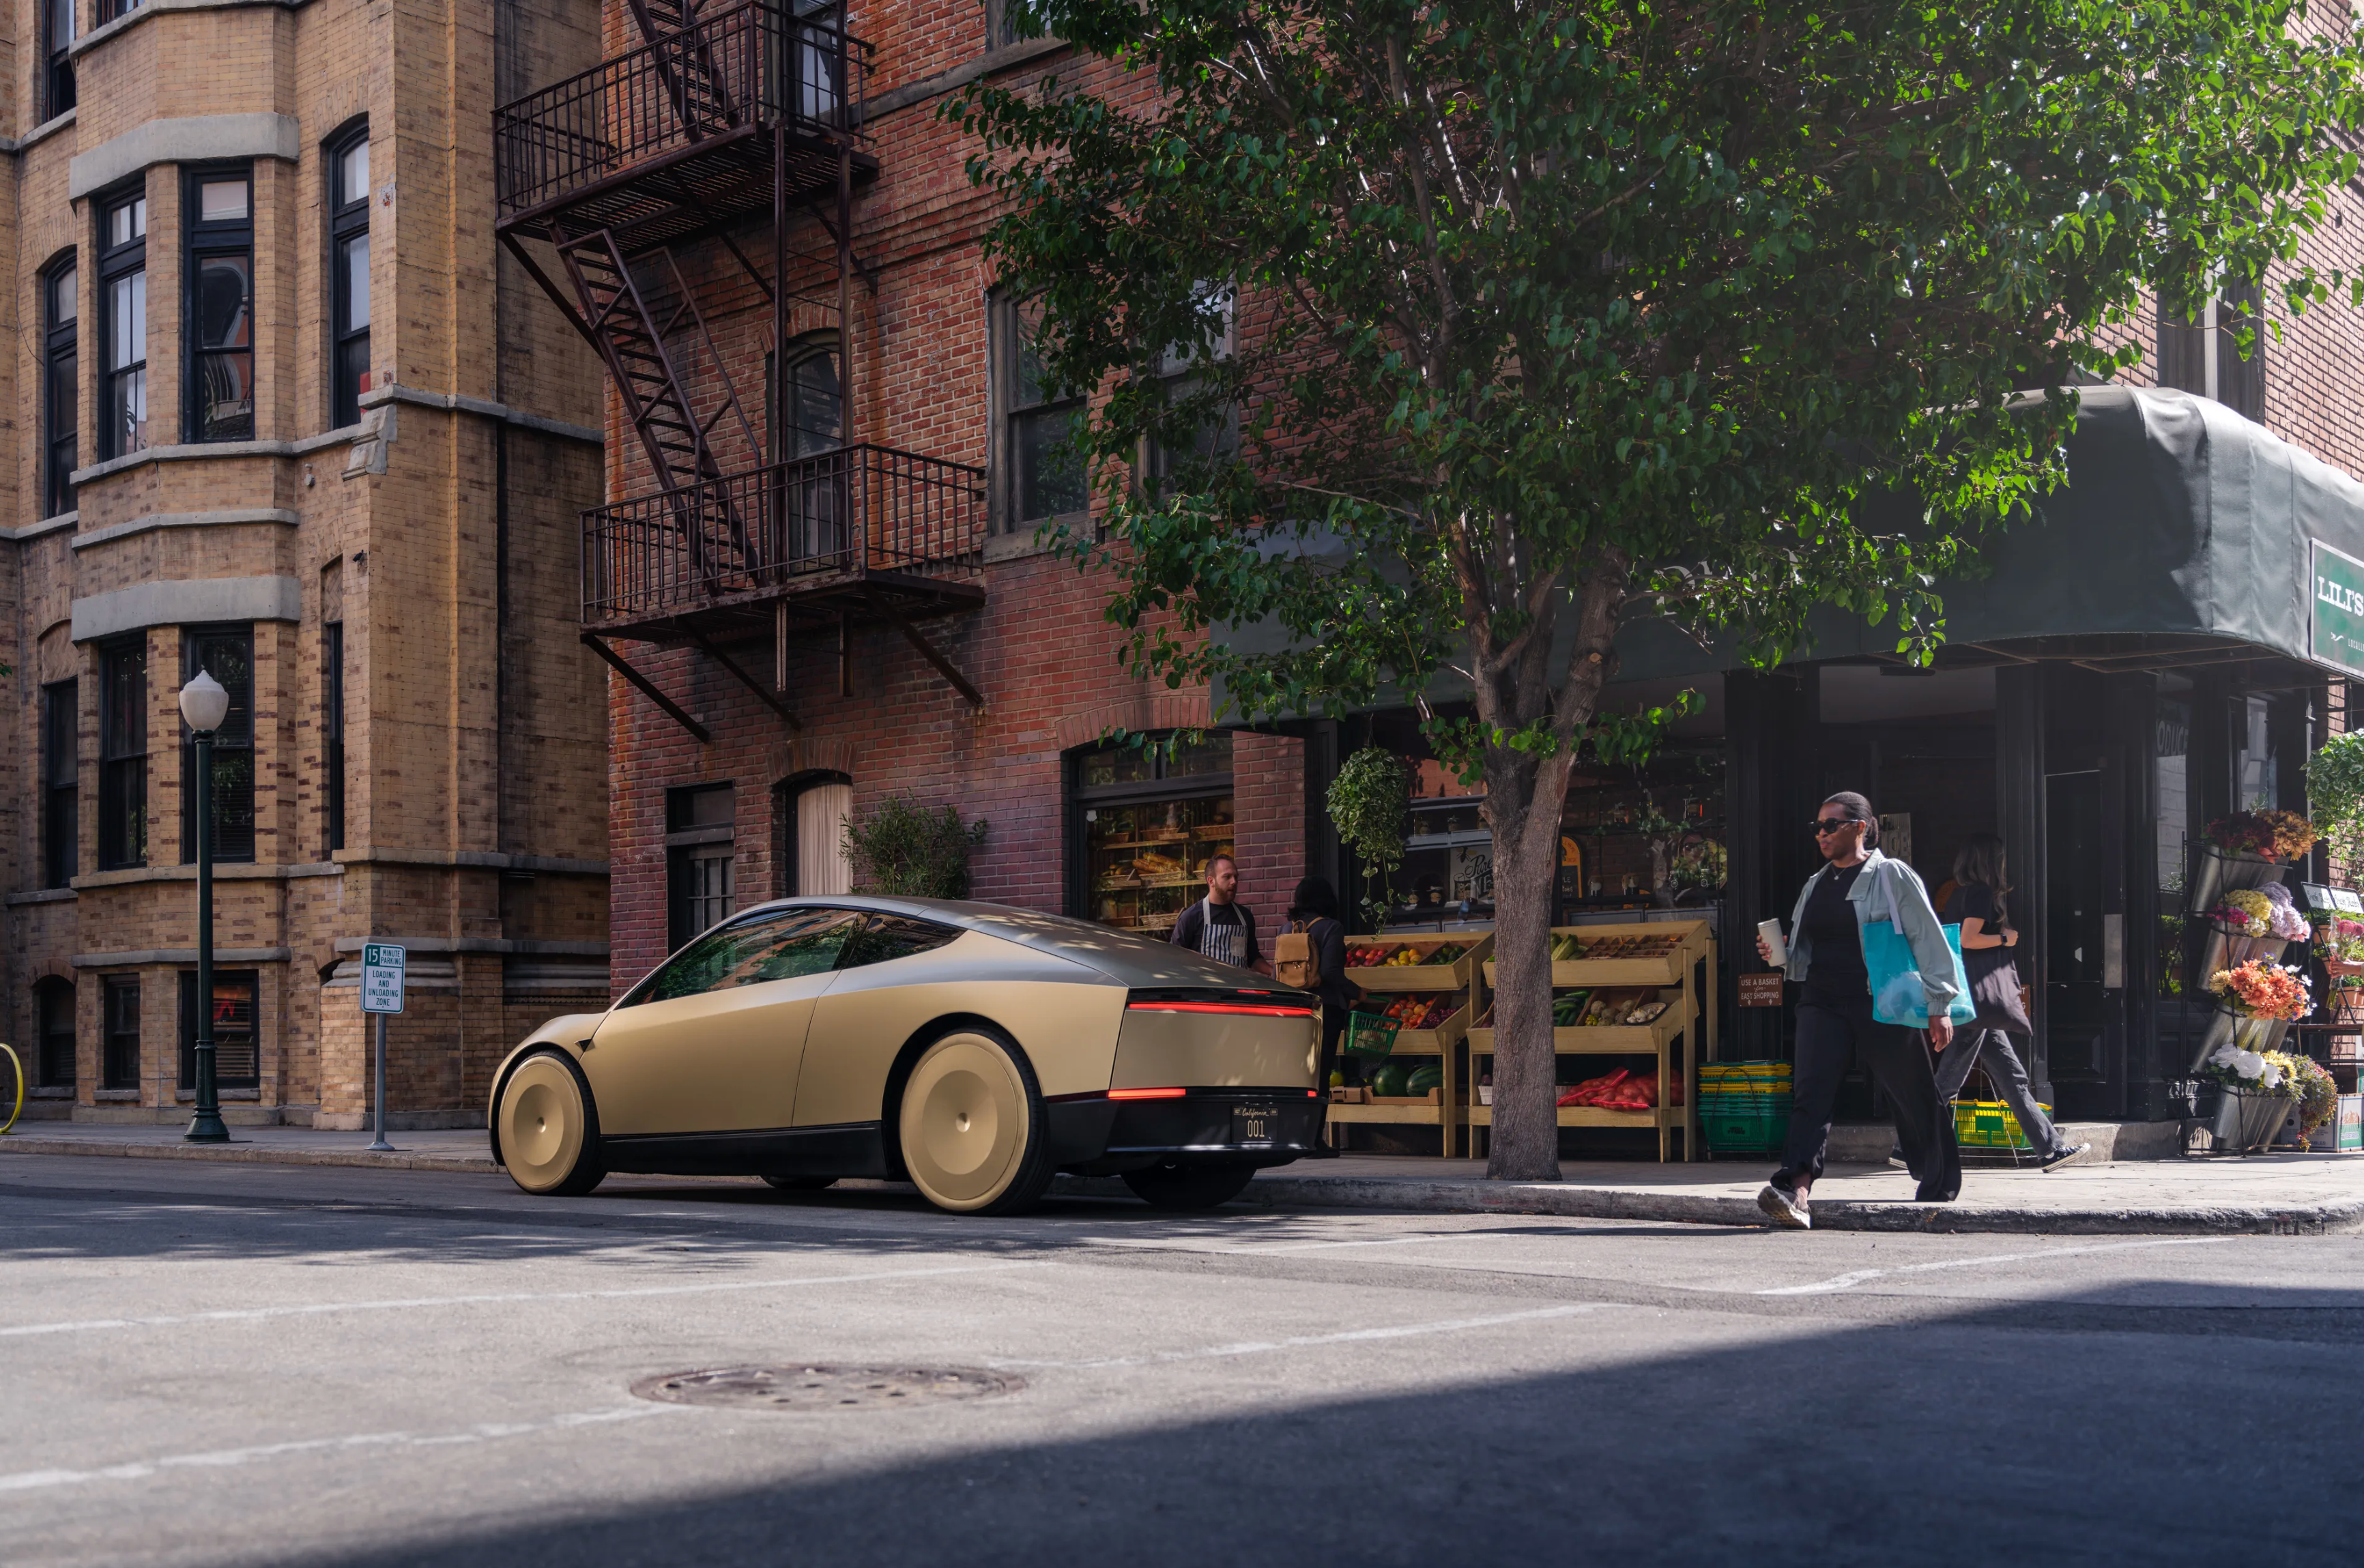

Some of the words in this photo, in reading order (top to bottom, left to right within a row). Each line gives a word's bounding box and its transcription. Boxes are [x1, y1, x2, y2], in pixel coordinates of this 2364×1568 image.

[2318, 576, 2364, 617] LILI'S
[2348, 638, 2364, 652] LOCALL
[2156, 720, 2189, 756] ODUCE
[1465, 854, 1493, 879] Pure
[369, 948, 378, 963] 15
[383, 949, 400, 957] MINUTE
[381, 957, 401, 966] PARKING
[373, 970, 395, 979] LOADING
[378, 980, 390, 988] AND
[369, 988, 399, 998] UNLOADING
[1753, 991, 1779, 1000] SHOPPING
[376, 998, 390, 1006] ZONE
[1242, 1107, 1269, 1118] California
[1248, 1120, 1265, 1137] 001
